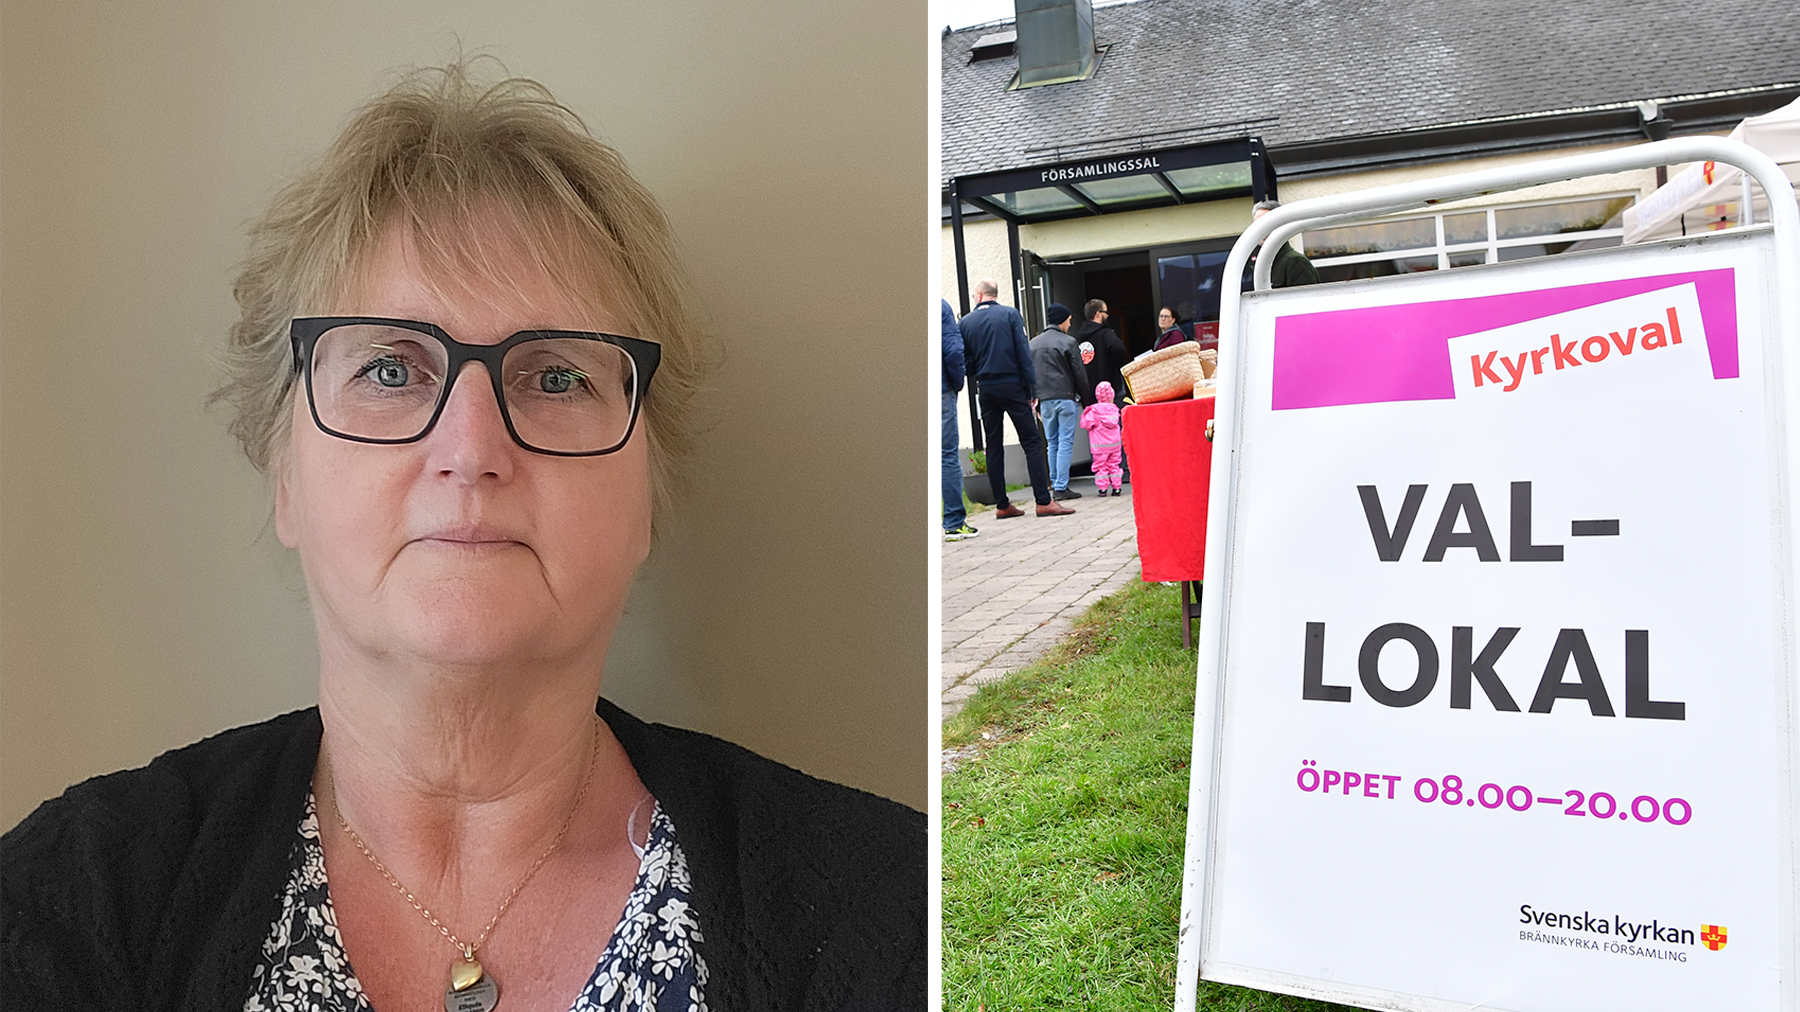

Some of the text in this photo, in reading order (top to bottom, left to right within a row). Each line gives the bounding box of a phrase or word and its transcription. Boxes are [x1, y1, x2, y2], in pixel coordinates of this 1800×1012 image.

[1041, 156, 1160, 183] FÖRSAMLINGSSAL
[1470, 306, 1683, 393] Kyrkoval
[1357, 481, 1619, 562] VAL-
[1303, 622, 1685, 720] LOKAL
[1297, 759, 1401, 799] ÖPPET
[1519, 904, 1695, 945] Svenska kyrkan
[1519, 930, 1688, 963] BRÄNNKYRKA FÖRSAMLING
